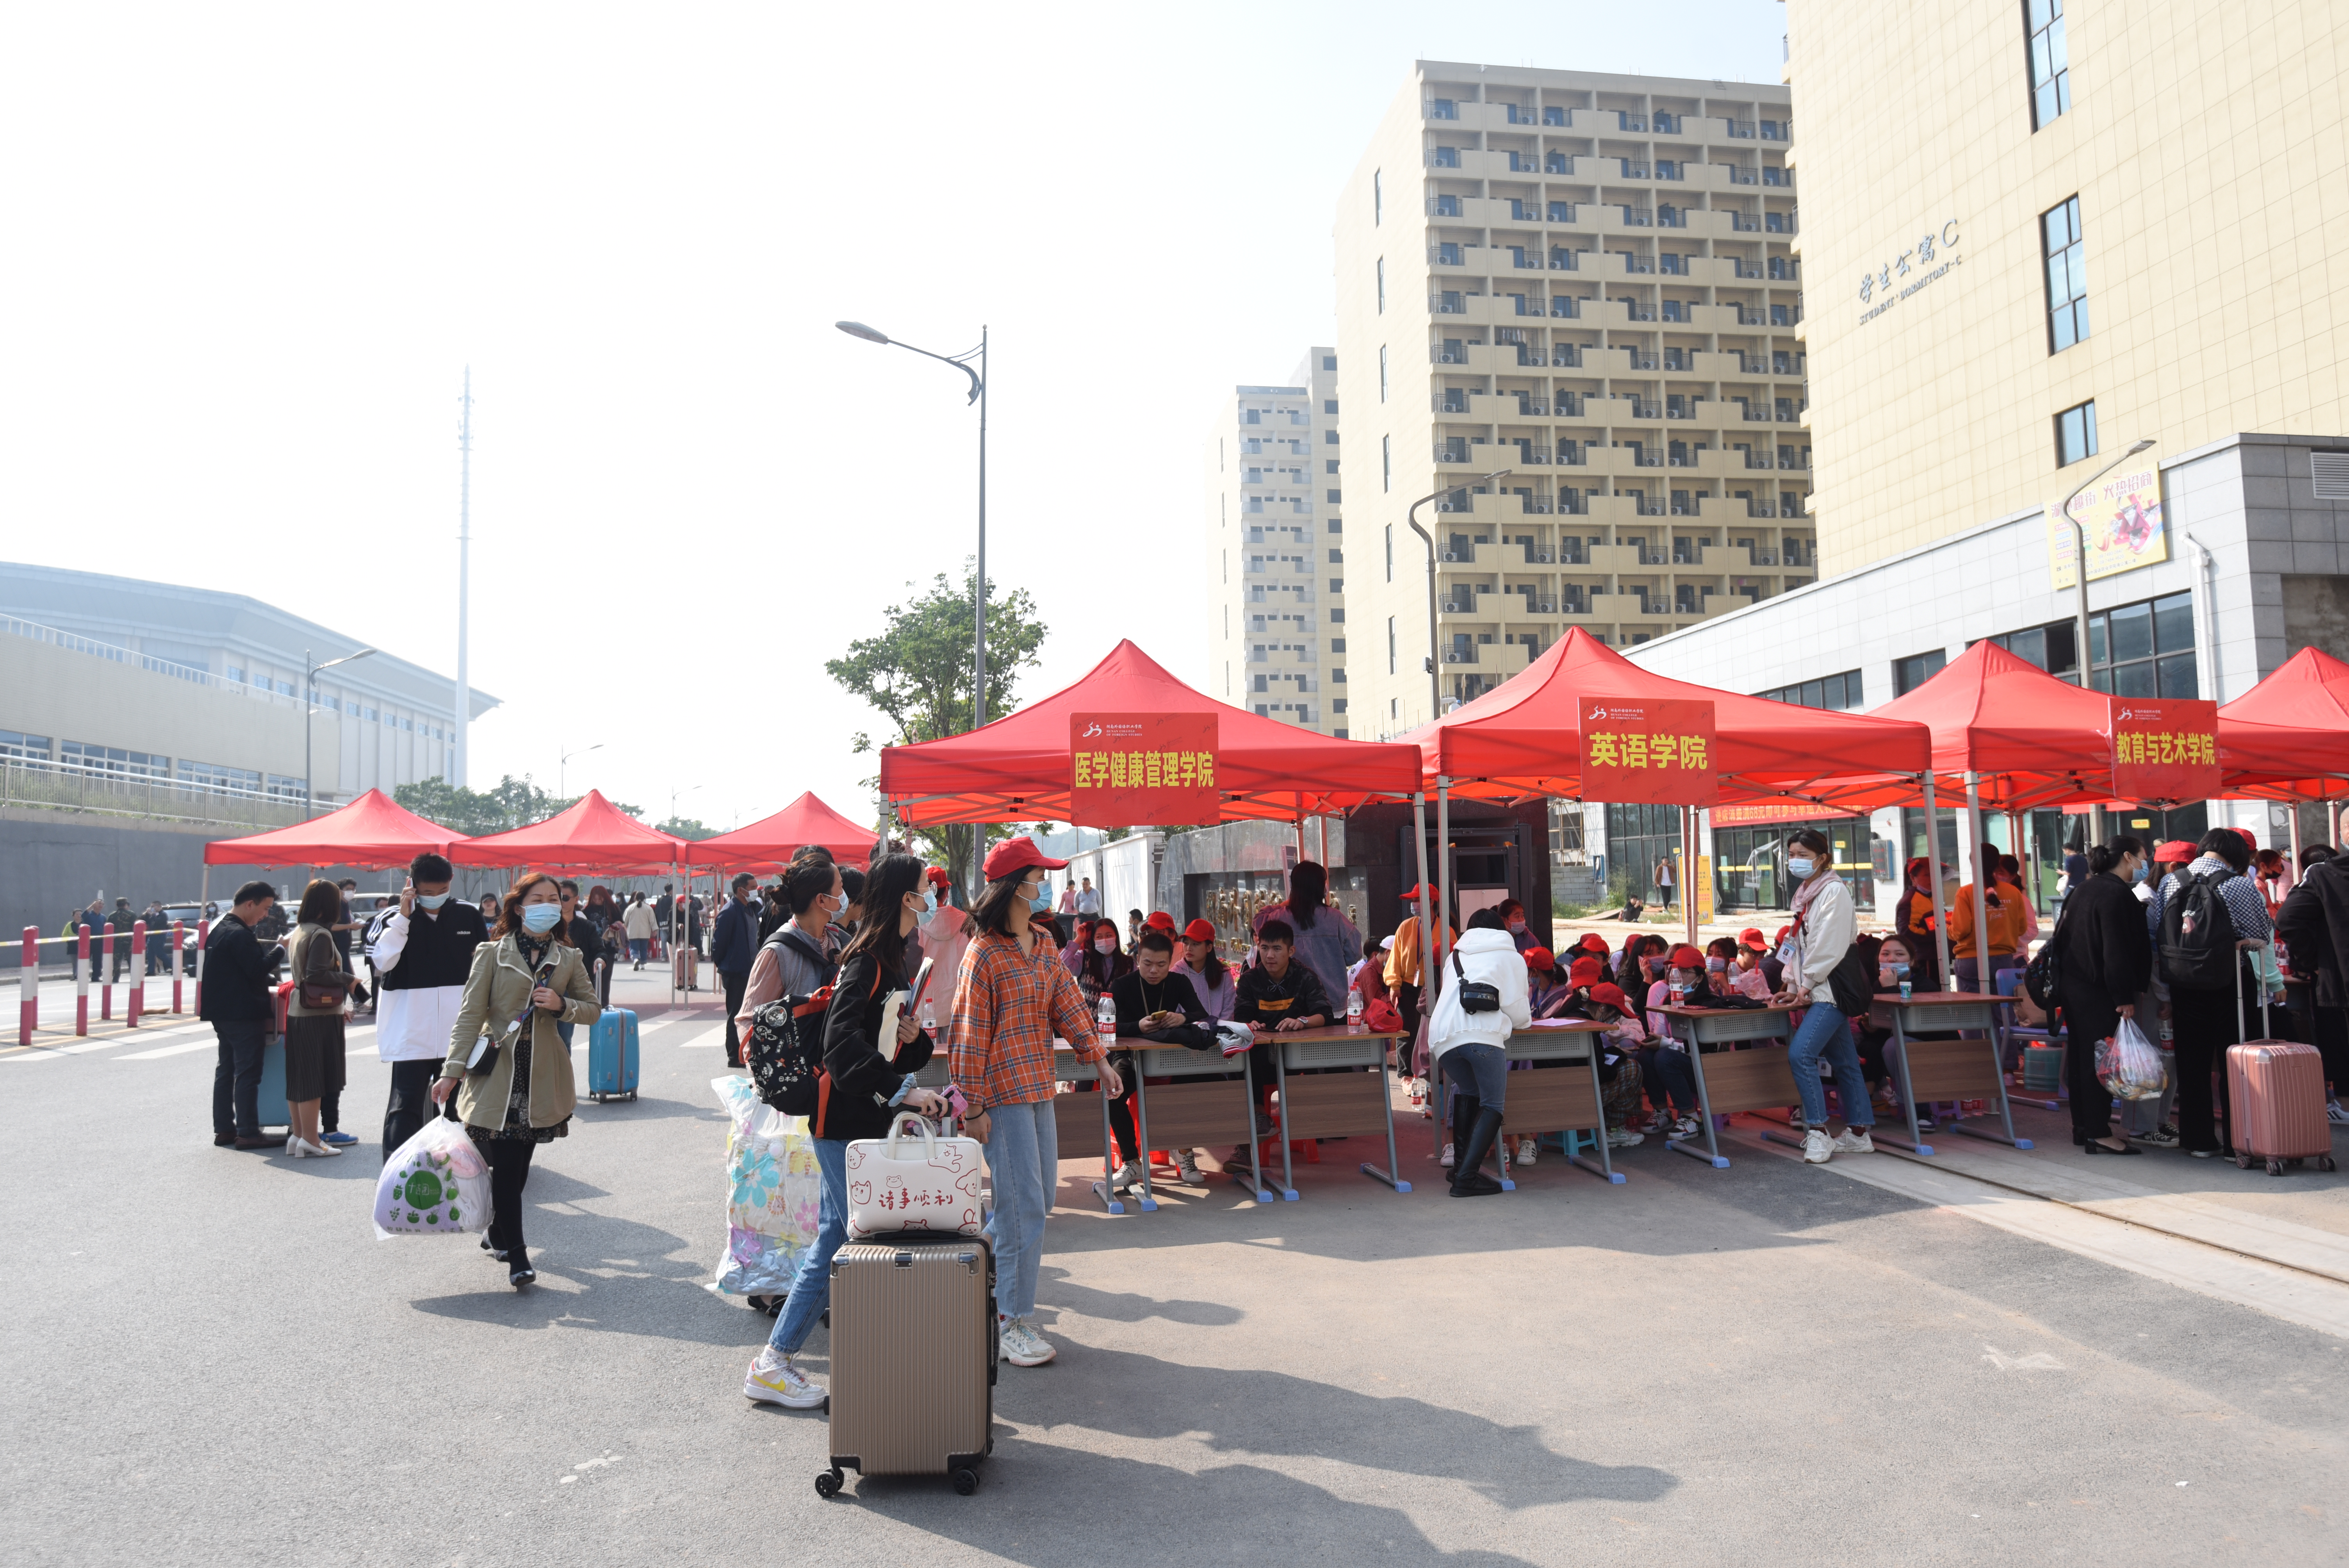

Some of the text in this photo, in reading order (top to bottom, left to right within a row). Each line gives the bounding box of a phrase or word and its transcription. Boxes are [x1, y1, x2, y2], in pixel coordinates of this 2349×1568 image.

[2103, 470, 2152, 501] 火热招商
[1589, 732, 1707, 770] 英语学院
[2116, 731, 2215, 765] 教育与艺术学院
[1075, 750, 1214, 788] 医学健康管理学院
[879, 1187, 954, 1210] 诸事顺利
